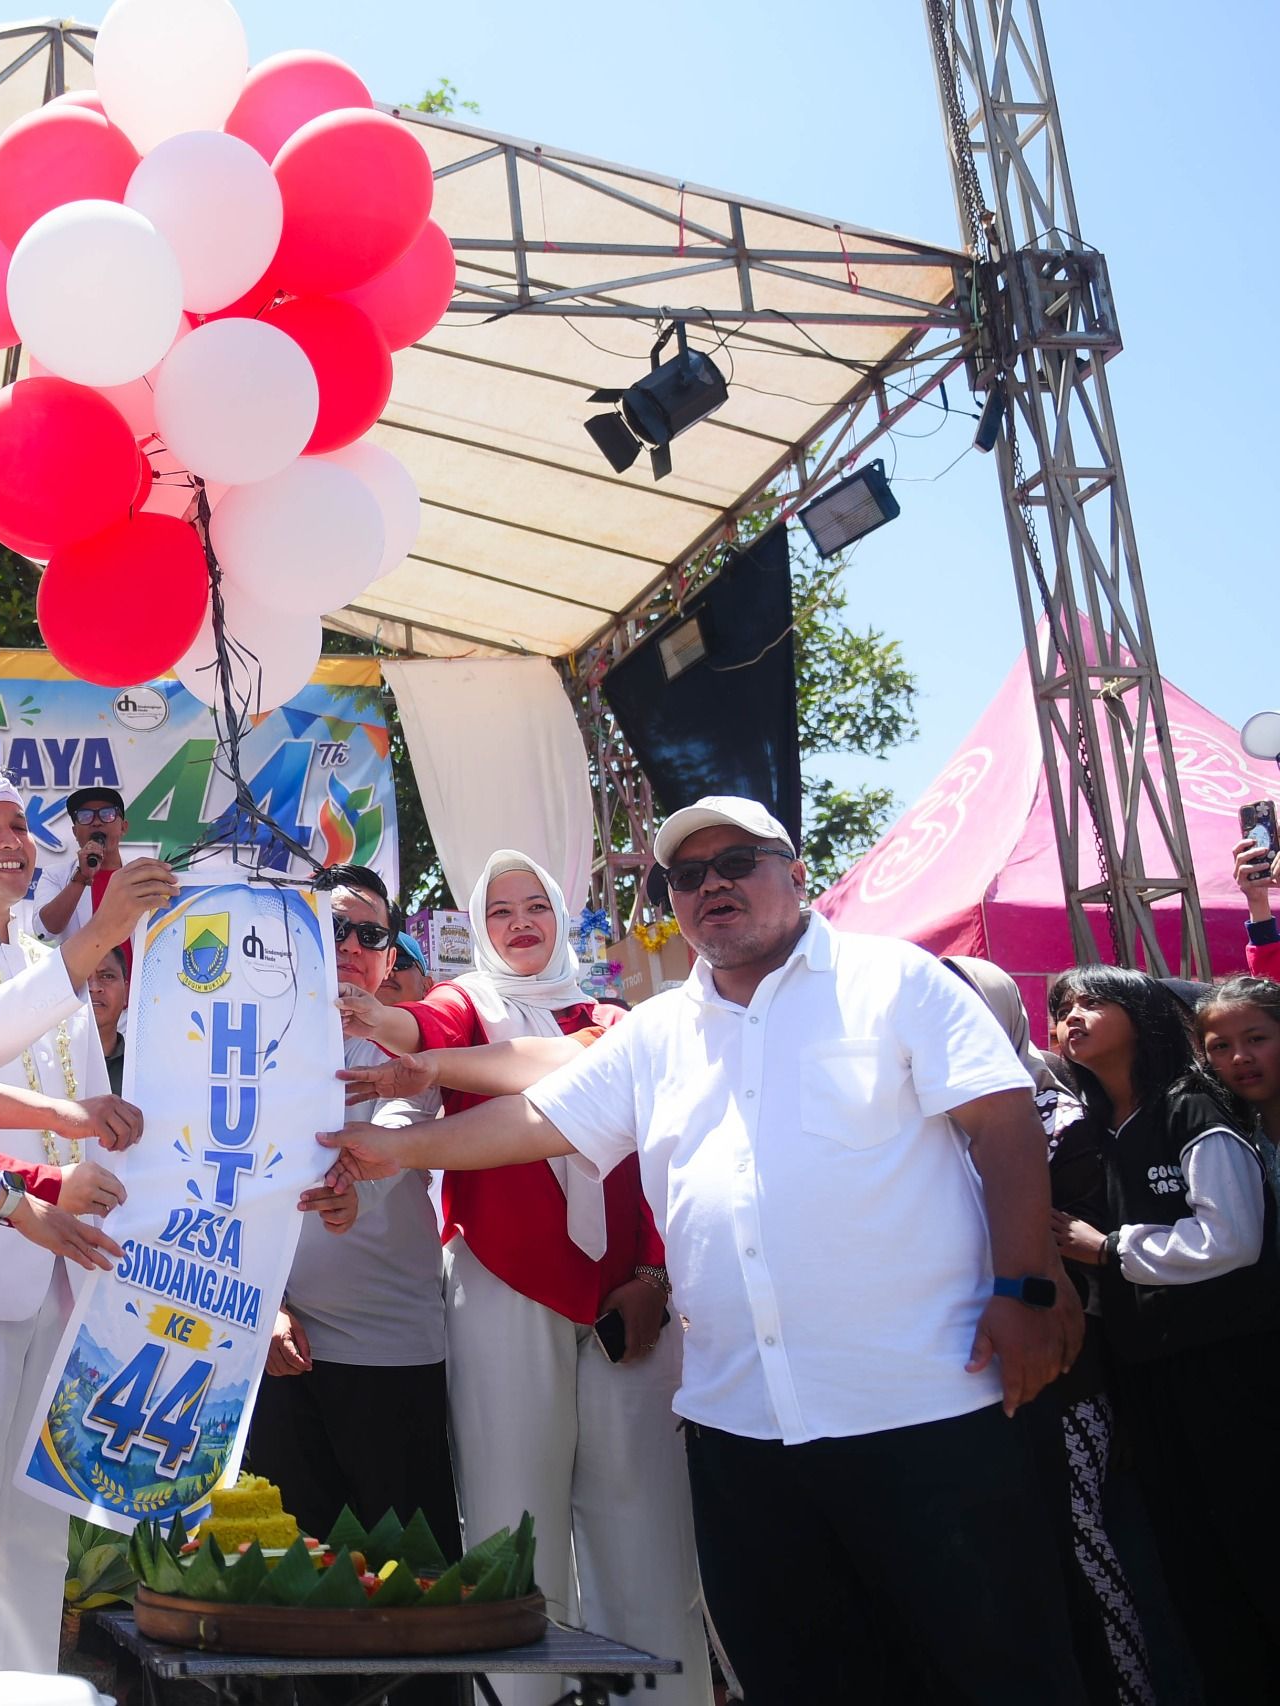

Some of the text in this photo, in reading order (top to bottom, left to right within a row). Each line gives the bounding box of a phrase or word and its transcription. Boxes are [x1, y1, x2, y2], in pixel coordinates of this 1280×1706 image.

[204, 1000, 260, 1209] HUT
[117, 1239, 264, 1331] SINDANGJAYA
[160, 1207, 244, 1271] DESA
[163, 1312, 197, 1344] KE
[84, 1342, 216, 1476] 44
